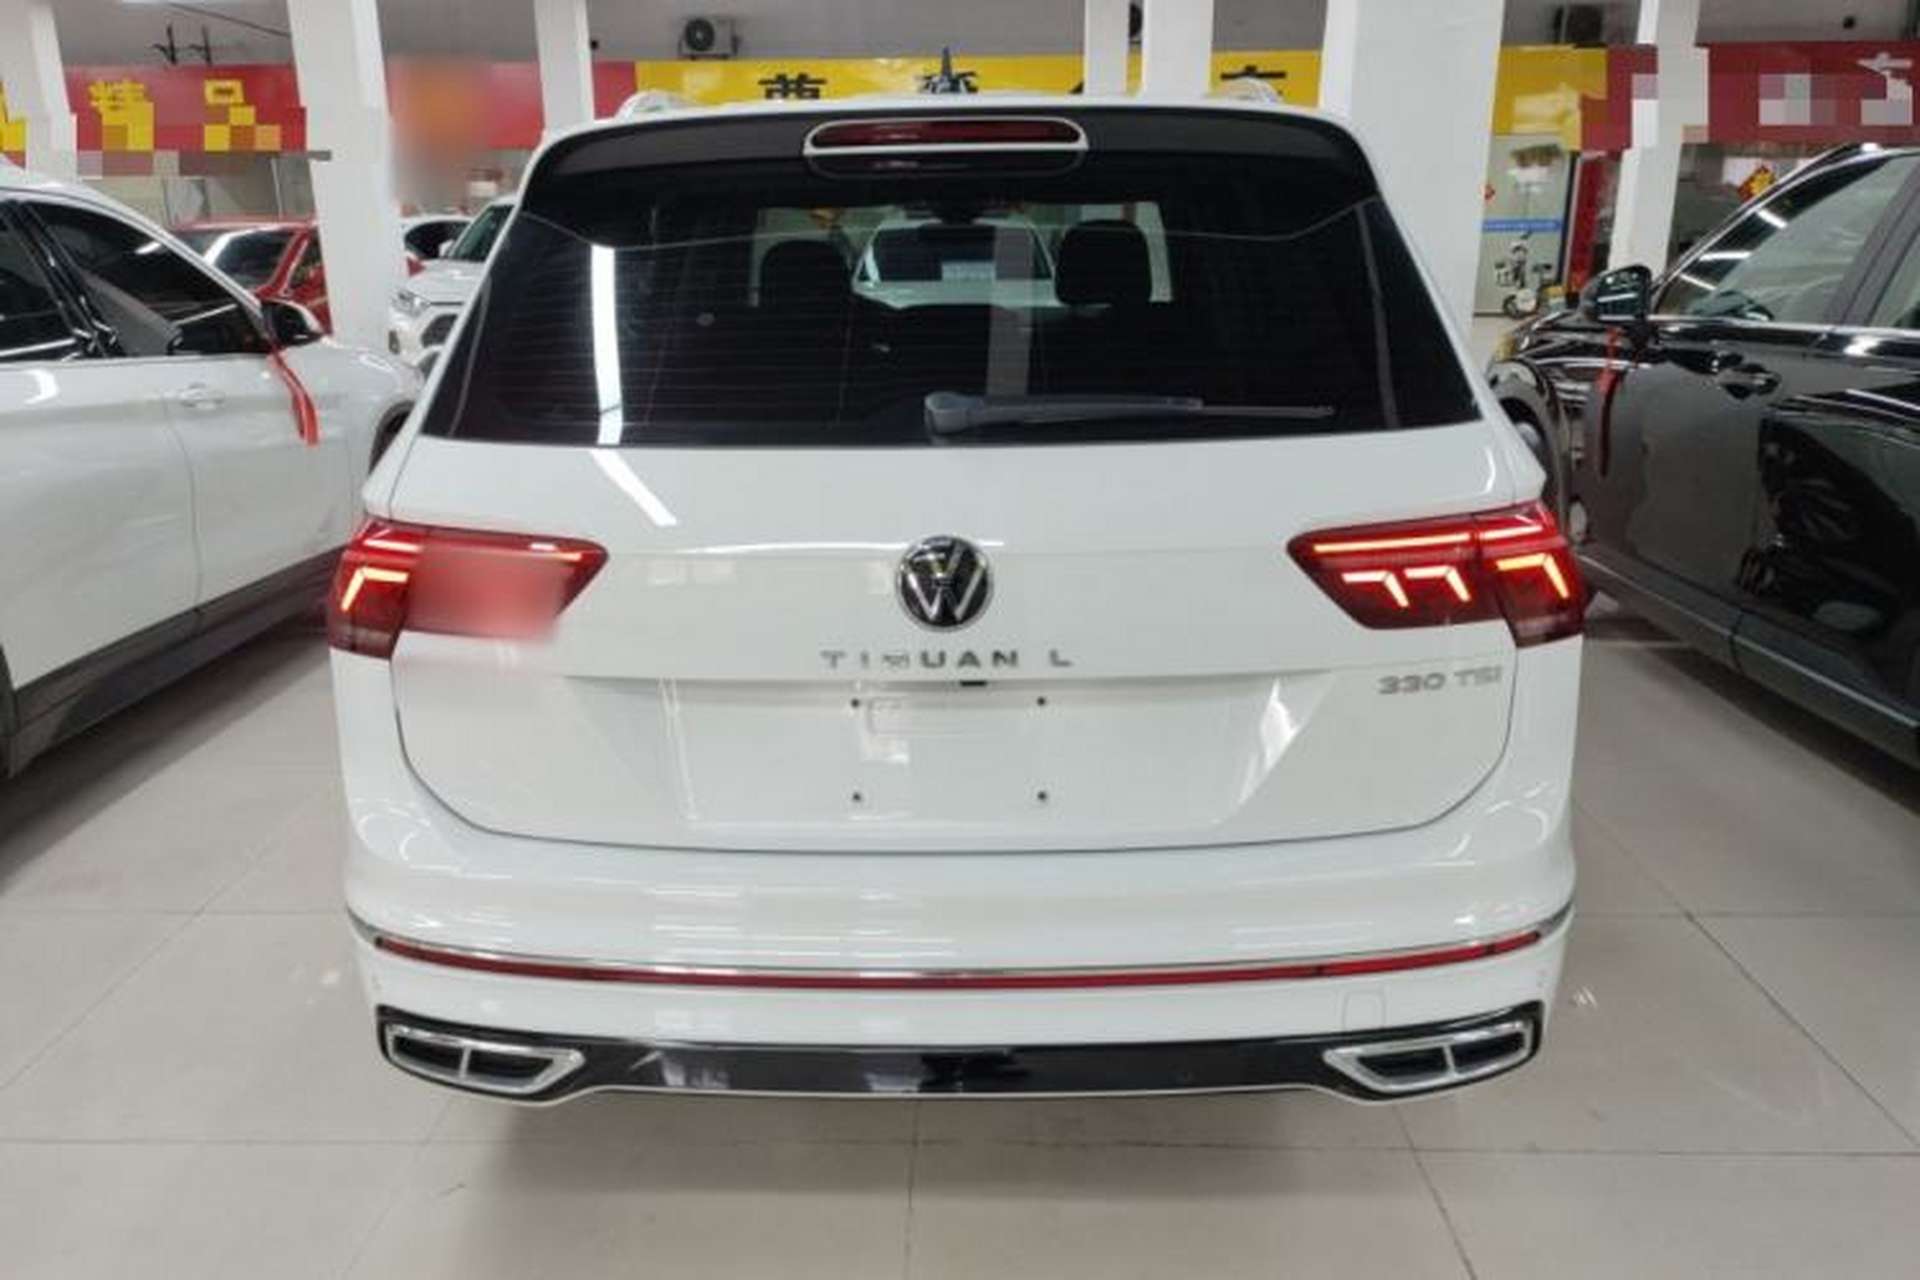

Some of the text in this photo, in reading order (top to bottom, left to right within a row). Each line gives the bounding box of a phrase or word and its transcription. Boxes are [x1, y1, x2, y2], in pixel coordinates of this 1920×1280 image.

[1049, 649, 1074, 667] L
[1378, 664, 1503, 695] 330 TSI
